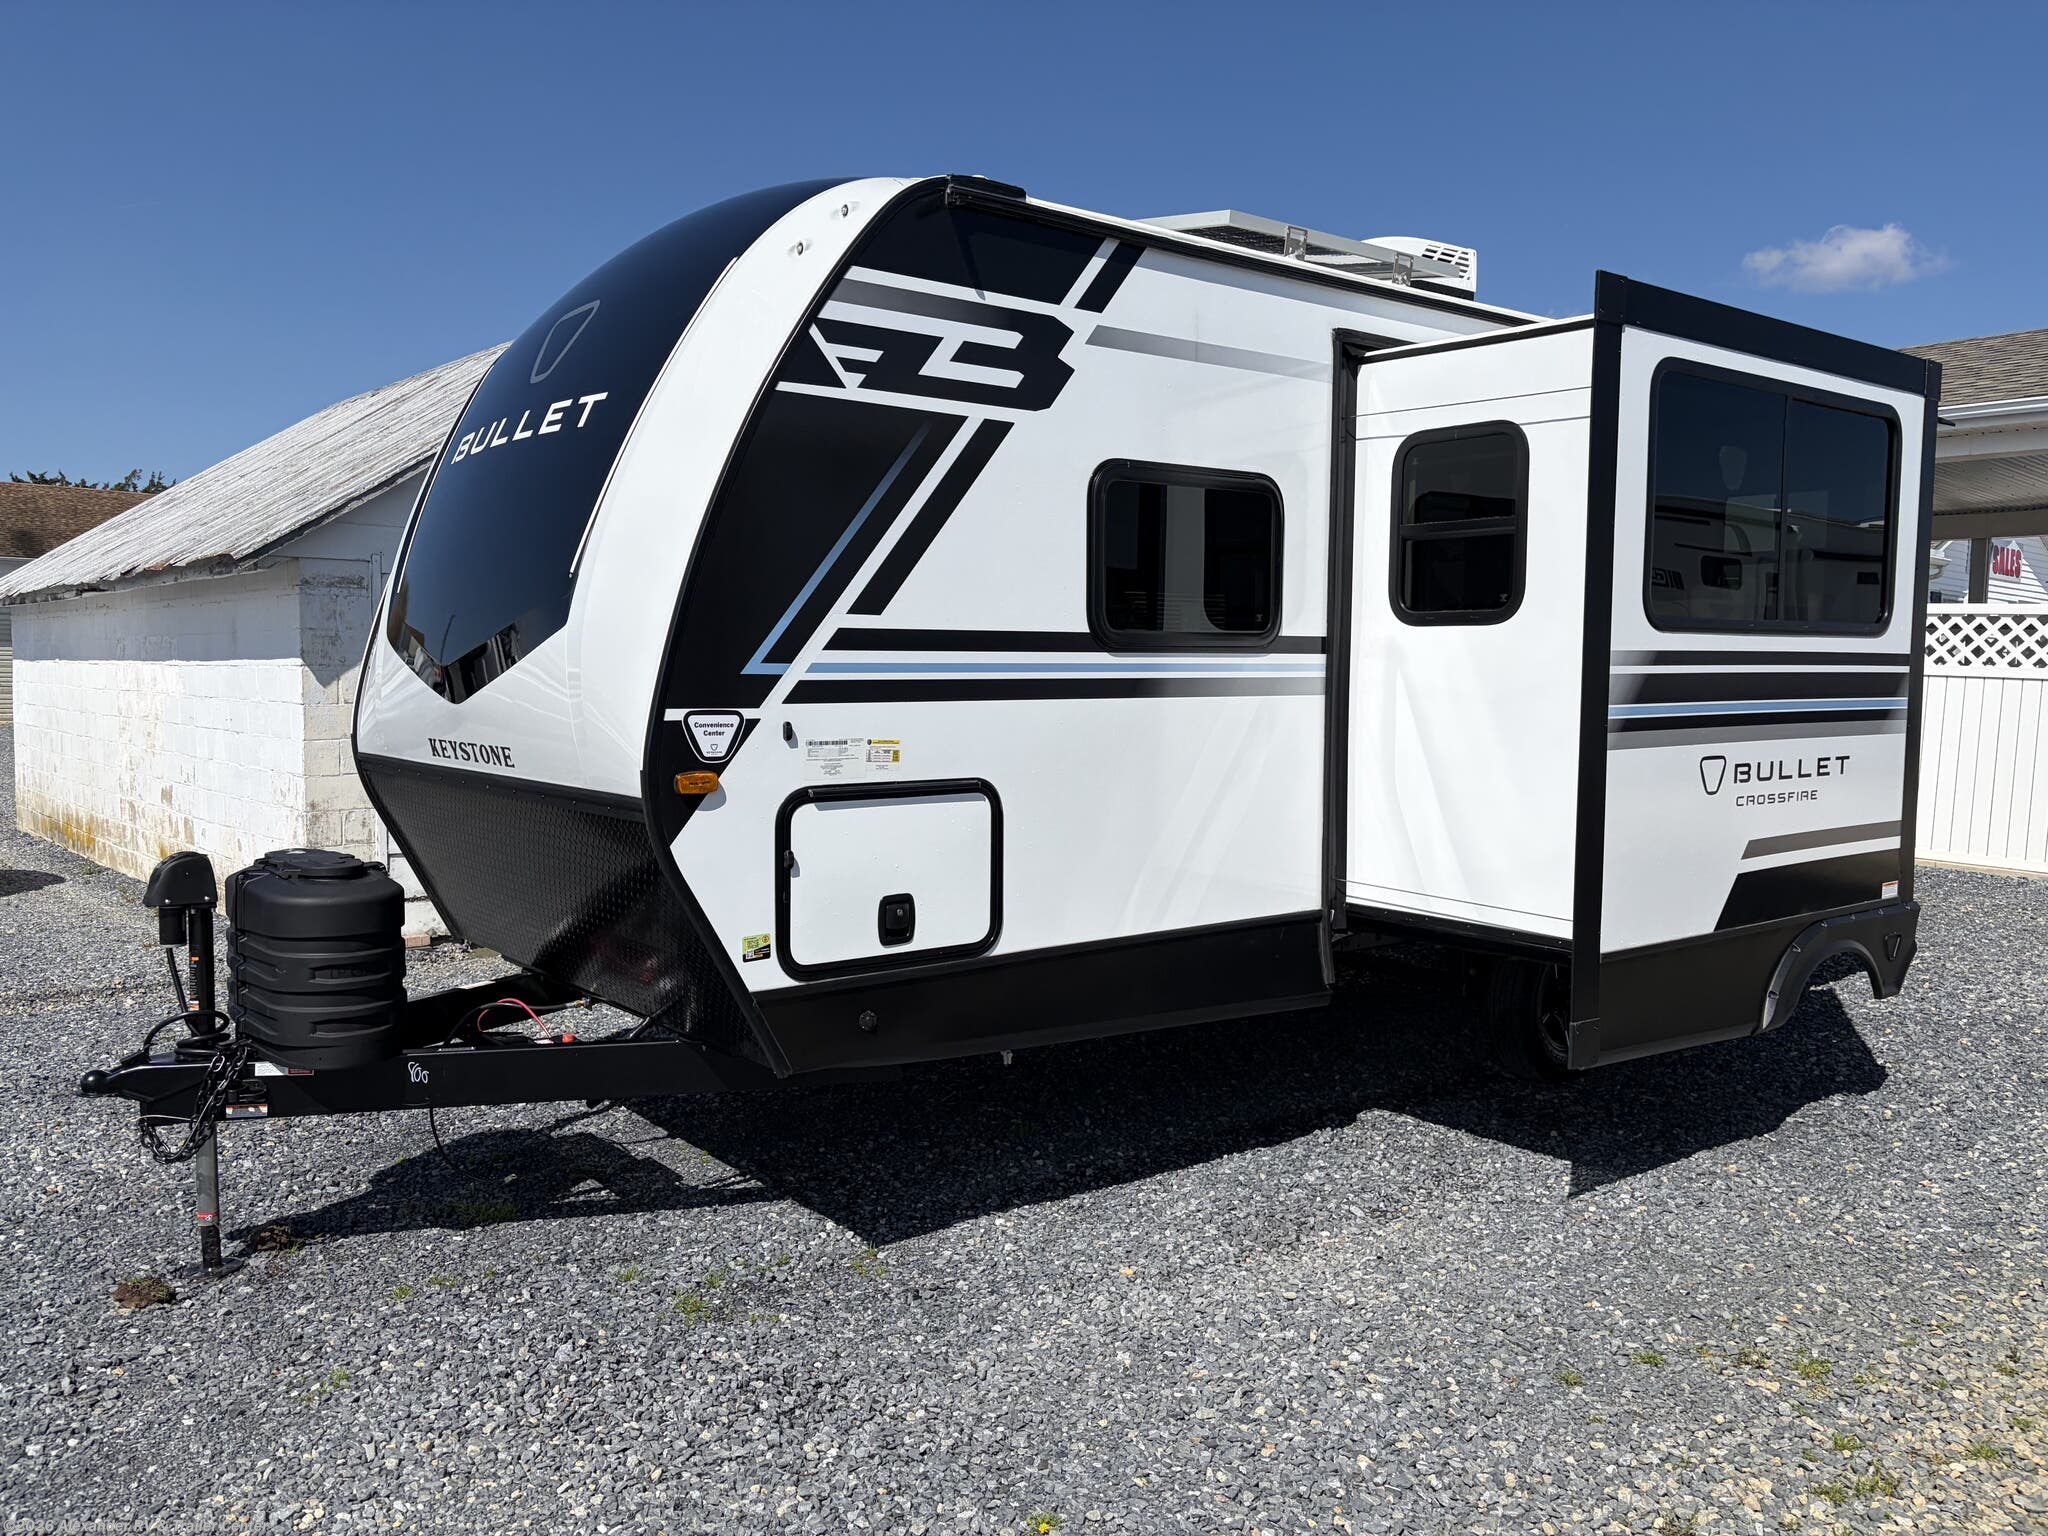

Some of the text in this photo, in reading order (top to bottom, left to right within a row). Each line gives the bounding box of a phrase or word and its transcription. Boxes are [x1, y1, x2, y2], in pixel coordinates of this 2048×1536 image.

[450, 391, 609, 465] BULLET
[1992, 544, 2022, 578] SALES
[428, 737, 516, 768] KEYSTONE
[1733, 755, 1850, 784] BULLET
[1735, 789, 1818, 807] CROSSFIRE
